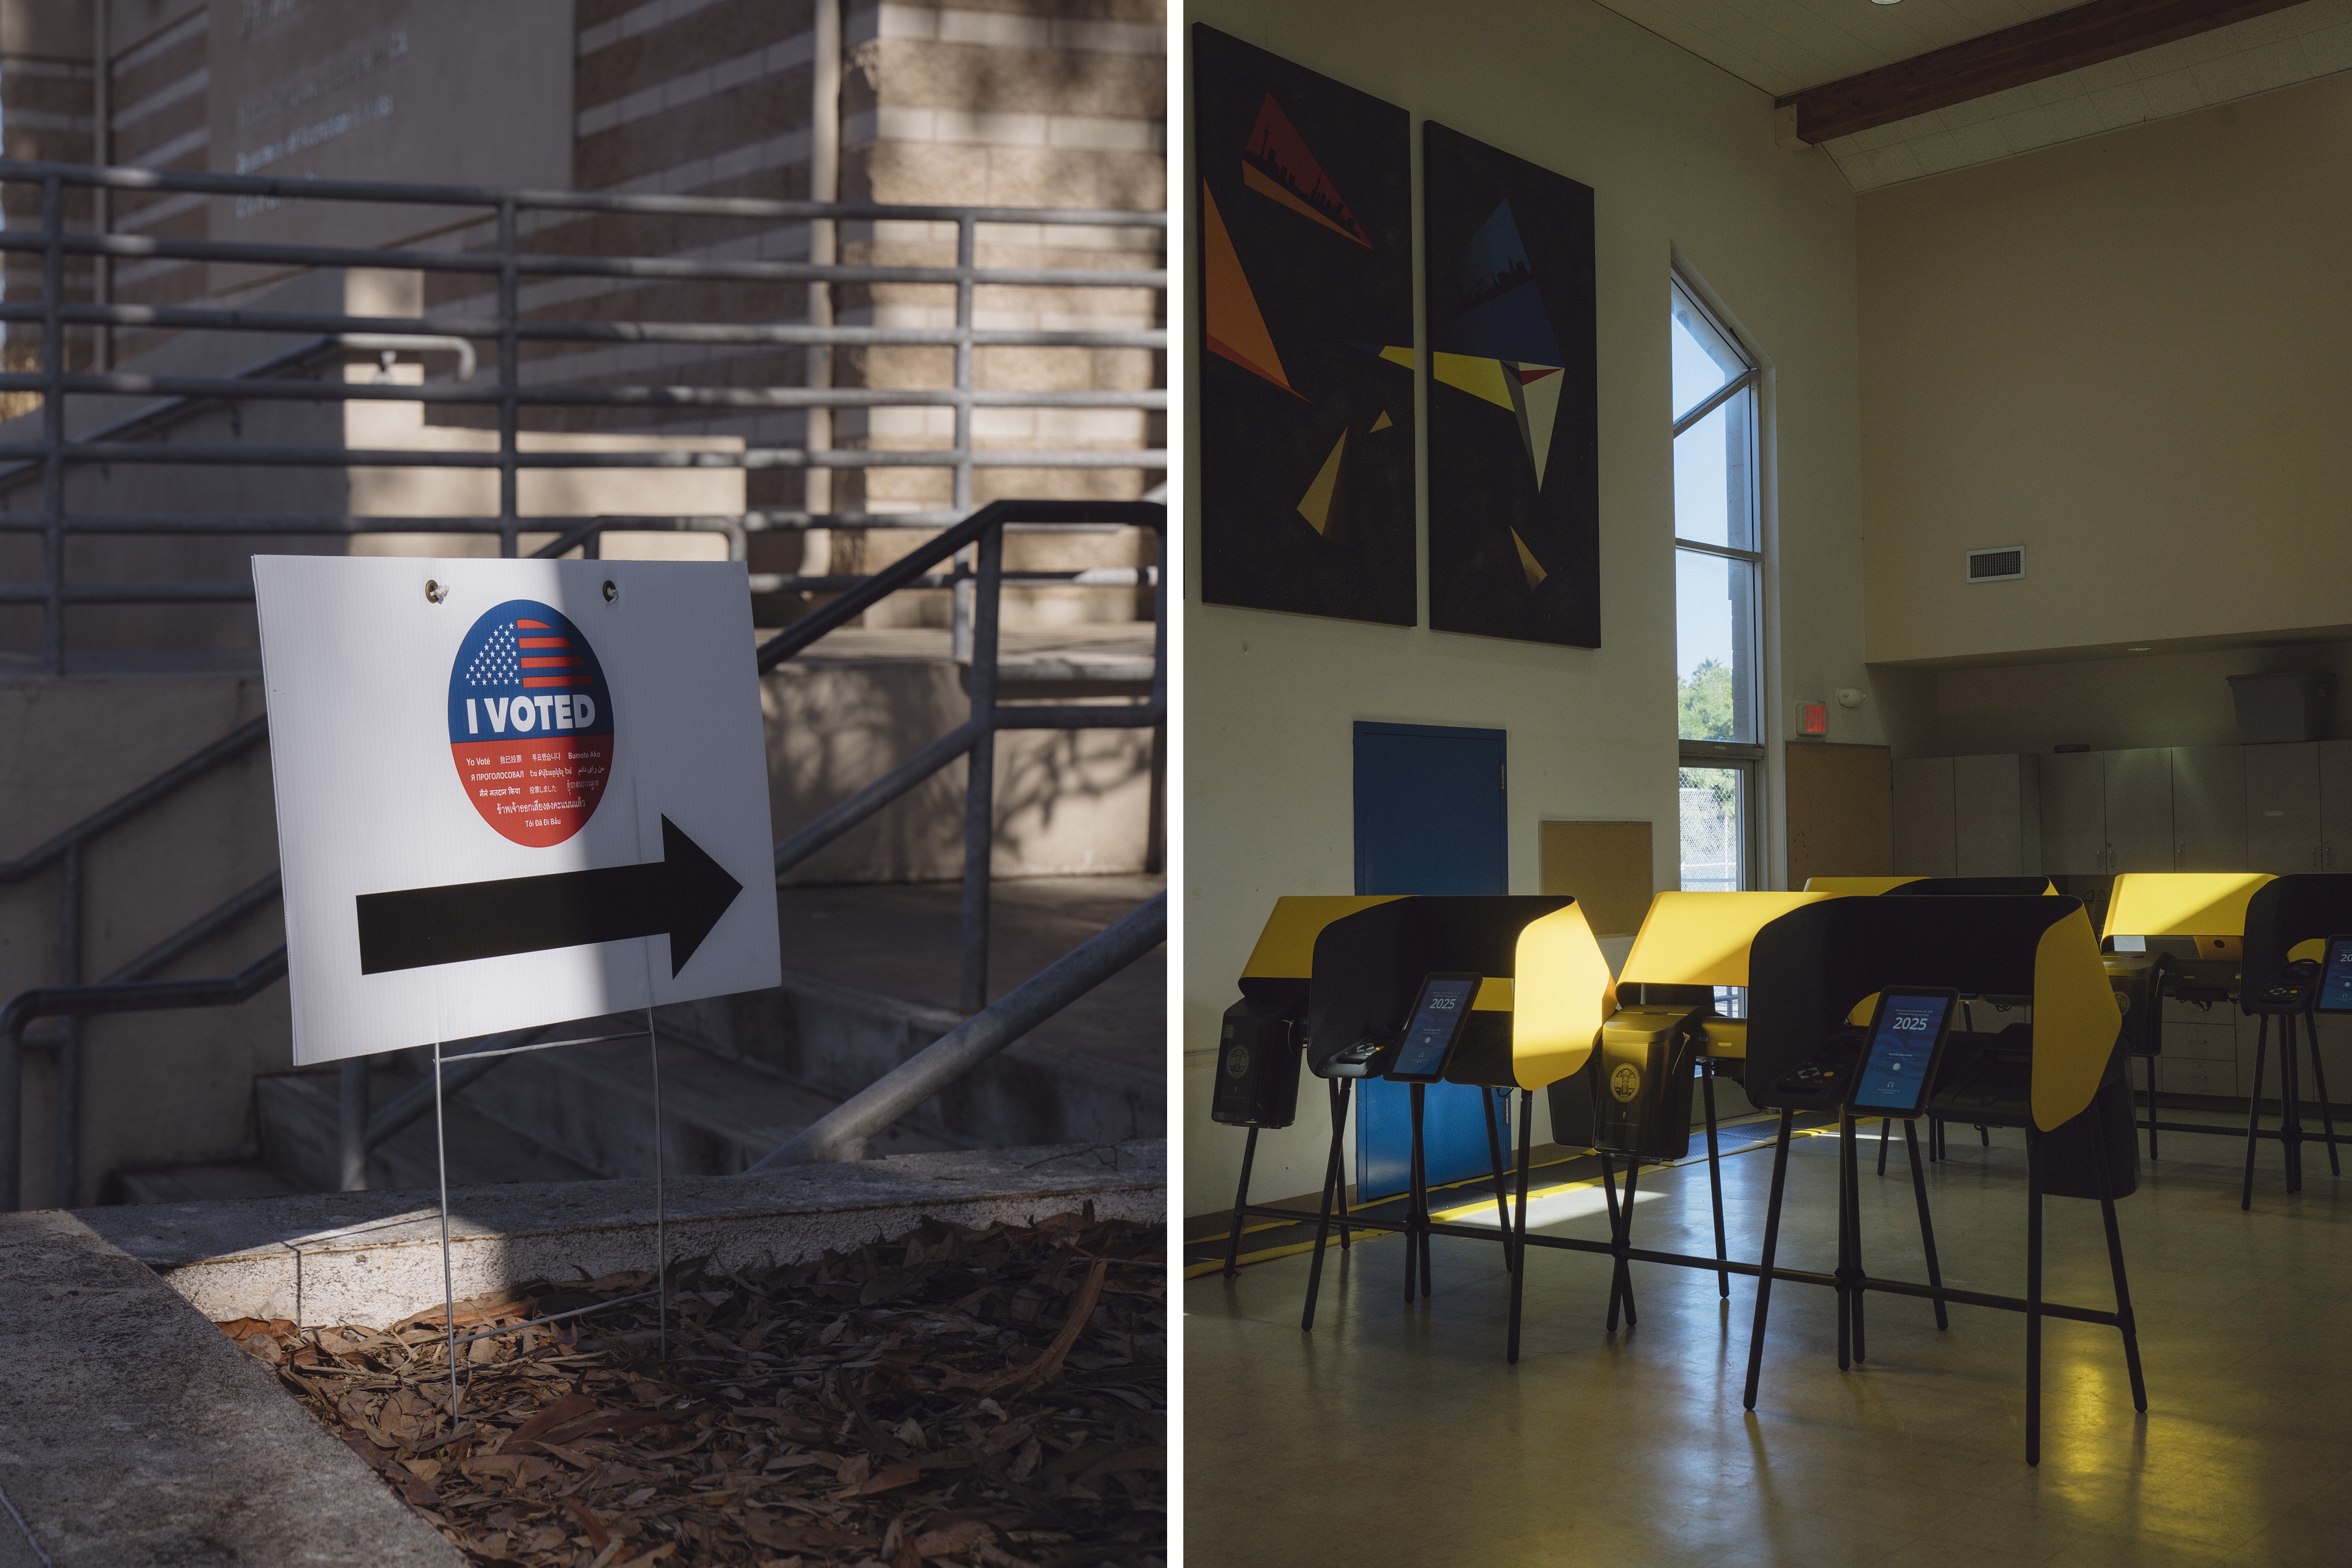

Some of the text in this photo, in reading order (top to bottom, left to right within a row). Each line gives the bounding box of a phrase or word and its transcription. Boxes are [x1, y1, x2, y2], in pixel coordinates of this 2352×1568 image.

[466, 694, 595, 734] I VOTED
[1806, 706, 1826, 733] EXIT
[476, 757, 490, 765] Voté
[500, 755, 522, 764] 我已投票
[532, 752, 561, 762] 투표했습니다
[476, 770, 524, 781] ПРОГОЛОСОВАЛ
[508, 786, 521, 795] किया
[529, 785, 557, 794] 投票しました
[525, 820, 534, 828] Tôi
[550, 816, 561, 826] Bầu
[1429, 998, 1456, 1009] 2025
[1893, 1017, 1928, 1030] 2025
